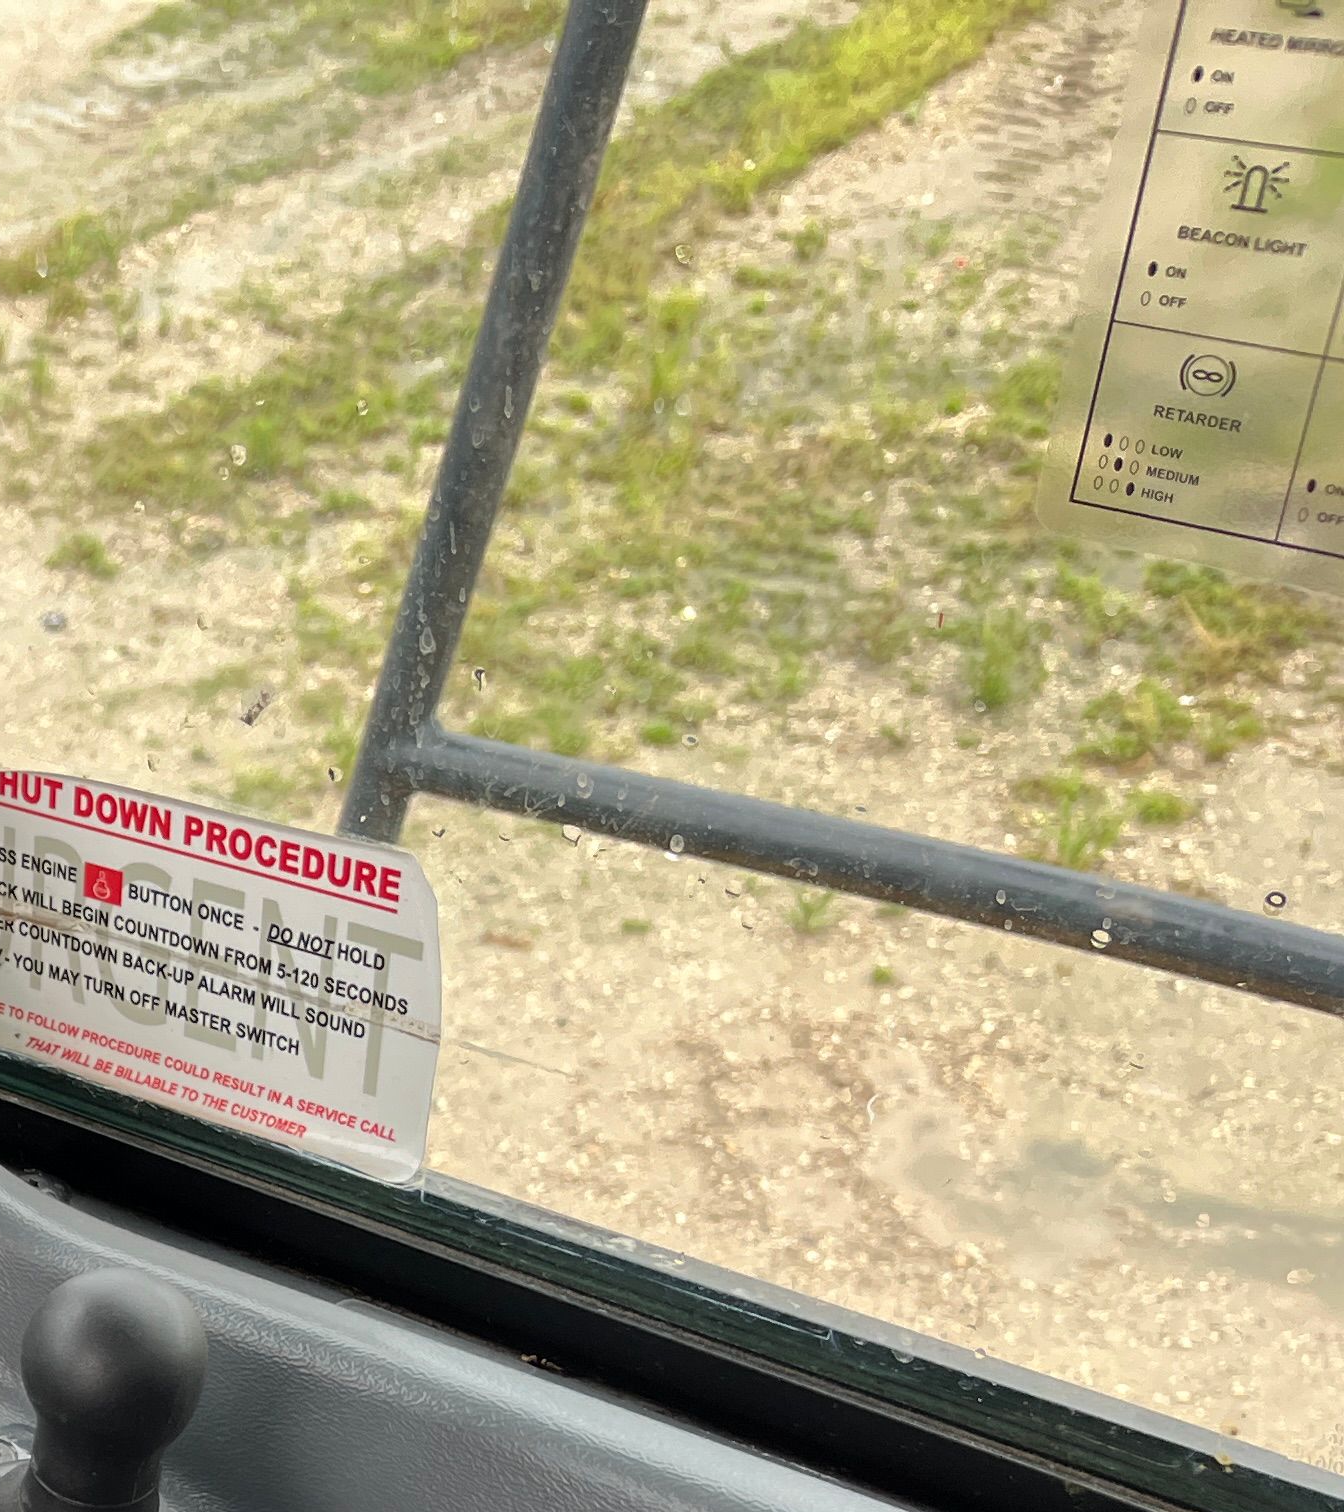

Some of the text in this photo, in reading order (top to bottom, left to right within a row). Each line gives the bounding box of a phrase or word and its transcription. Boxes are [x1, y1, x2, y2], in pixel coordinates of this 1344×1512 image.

[1211, 69, 1235, 84] ON
[1203, 101, 1235, 114] OFF
[1177, 225, 1308, 257] BEACON LIGHT
[1165, 265, 1188, 279] ON
[1158, 294, 1188, 308] OFF
[1153, 404, 1243, 432] RETARDER
[1151, 444, 1184, 459] LOW
[1145, 466, 1201, 487] MEDIUM
[1140, 488, 1174, 503] HIGH
[73, 785, 171, 841] DOWN
[183, 815, 402, 903] PROCEDURE
[21, 854, 78, 883] ENGINE
[128, 883, 193, 916] BUTTON
[198, 903, 245, 931] ONCE
[267, 923, 294, 944] DO
[298, 931, 336, 957] NOT
[337, 942, 386, 971] HOLD
[22, 887, 58, 913] WILL
[62, 899, 109, 928] BEGIN
[113, 915, 220, 960] COUNTDOWN
[224, 947, 272, 975] FROM
[276, 962, 319, 989] 5-120
[324, 976, 409, 1016] SECONDS
[19, 920, 118, 964] COUNTDOWN
[122, 951, 195, 986] BACK-UP
[197, 975, 256, 1006] ALARM
[260, 992, 300, 1020] WILL
[305, 1007, 366, 1039] SOUND
[13, 952, 44, 976] YOU
[48, 963, 79, 987] MAY
[83, 974, 125, 1002] TURN
[129, 990, 161, 1012] OFF
[164, 999, 232, 1036] MASTER
[235, 1023, 300, 1056] SWITCH
[8, 1005, 24, 1021] TO
[26, 1011, 81, 1039] FOLLOW
[81, 1029, 162, 1065] PROCEDURE
[164, 1055, 210, 1081] COULD
[213, 1071, 266, 1099] RESULT
[267, 1088, 282, 1104] IN
[283, 1095, 294, 1109] A
[296, 1098, 357, 1129] SERVICE
[360, 1119, 397, 1143] CALL
[25, 1035, 307, 1139] THAT WILL BE BILLABLE TO THE CUSTOMER
